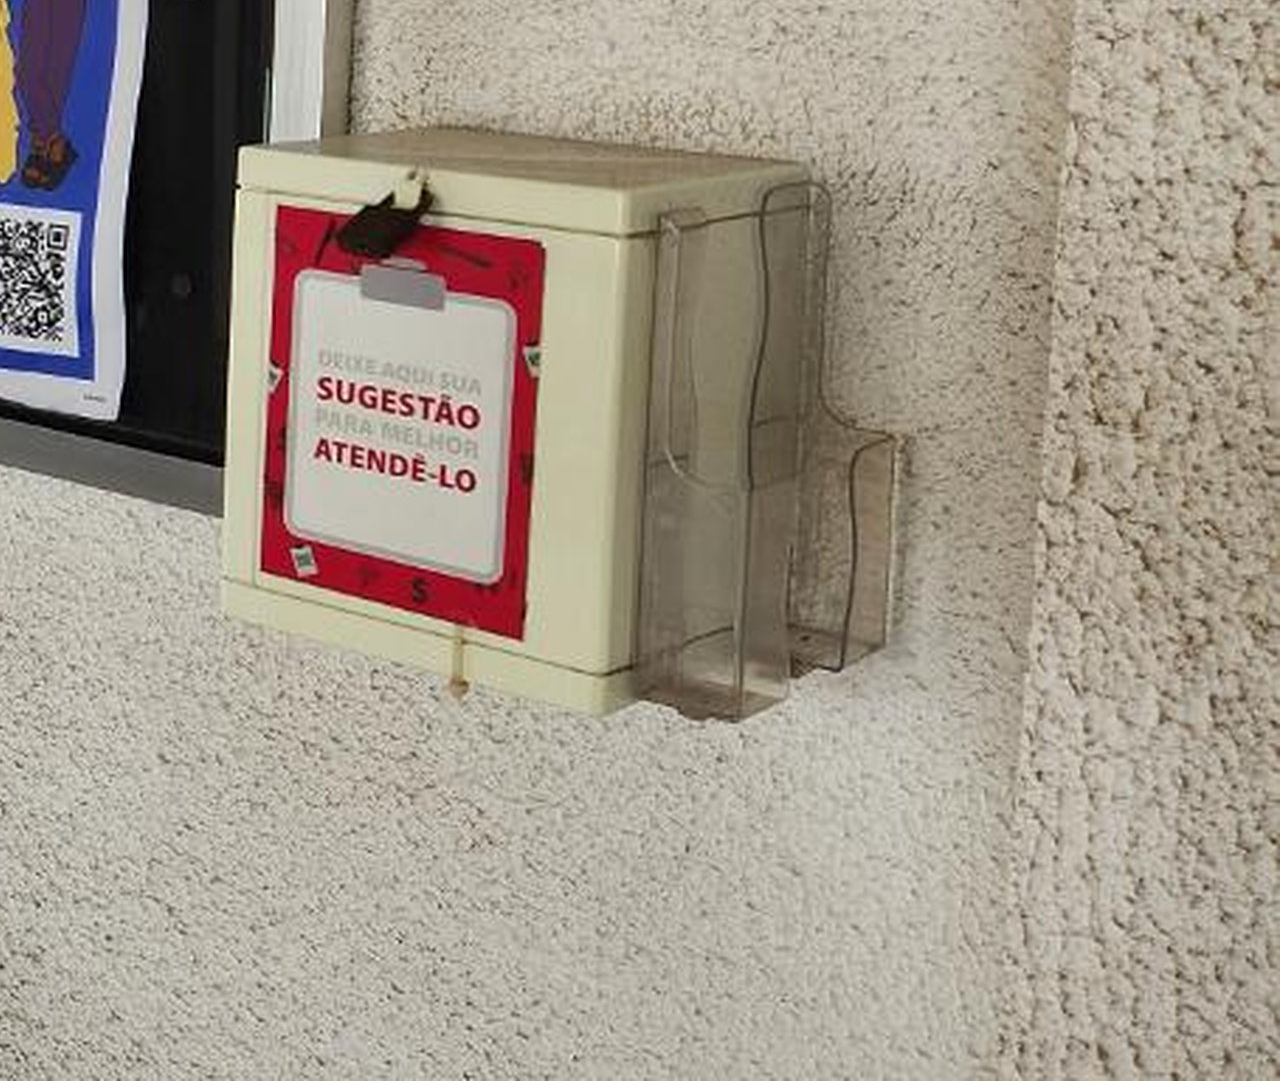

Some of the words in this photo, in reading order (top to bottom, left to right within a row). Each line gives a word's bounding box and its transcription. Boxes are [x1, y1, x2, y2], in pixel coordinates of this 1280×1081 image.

[317, 349, 381, 376] DEIXE
[383, 360, 436, 387] AQUI
[440, 371, 482, 397] SUA
[316, 376, 481, 430] SUGESTÃO
[315, 406, 374, 436] PARA
[380, 422, 479, 459] MELHOR
[313, 436, 478, 493] ATENDÊ-LO
